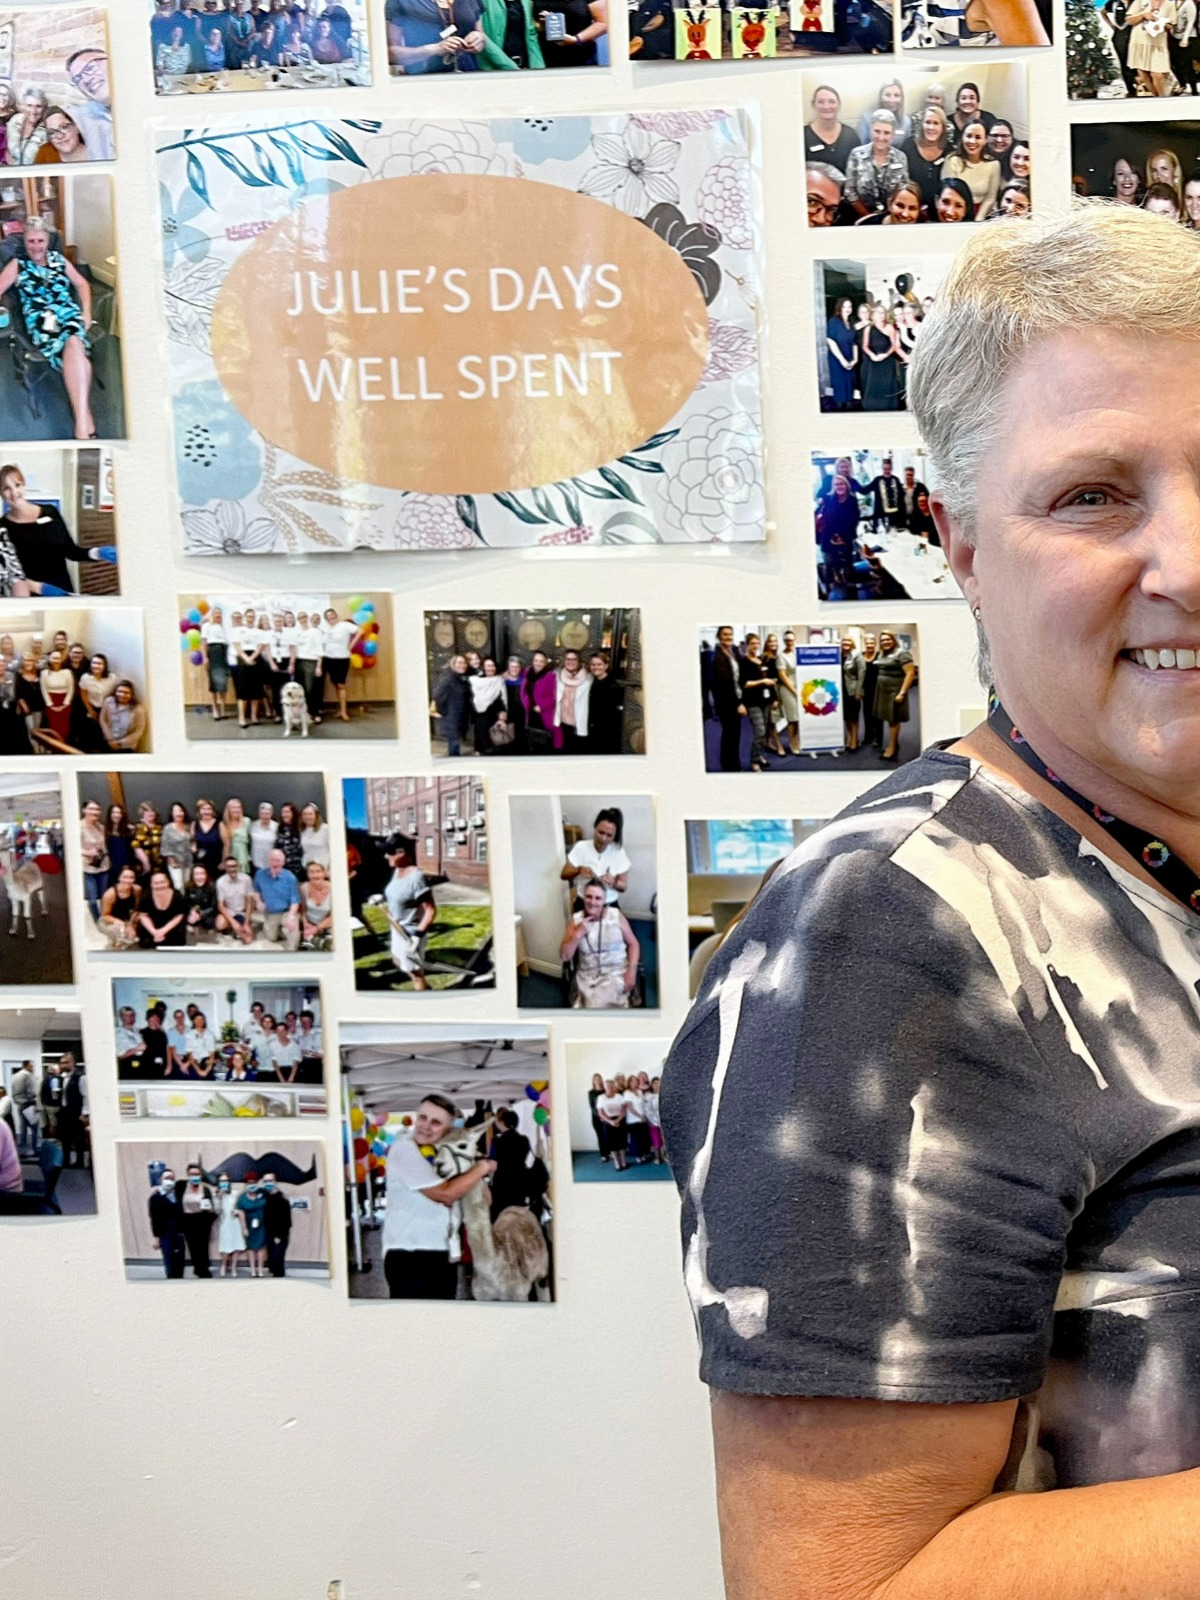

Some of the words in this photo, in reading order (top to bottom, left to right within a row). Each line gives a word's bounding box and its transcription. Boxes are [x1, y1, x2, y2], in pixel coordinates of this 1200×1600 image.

[286, 266, 471, 316] JULIE’S
[489, 264, 622, 312] DAYS
[297, 356, 444, 402] WELL
[457, 351, 622, 400] SPENT
